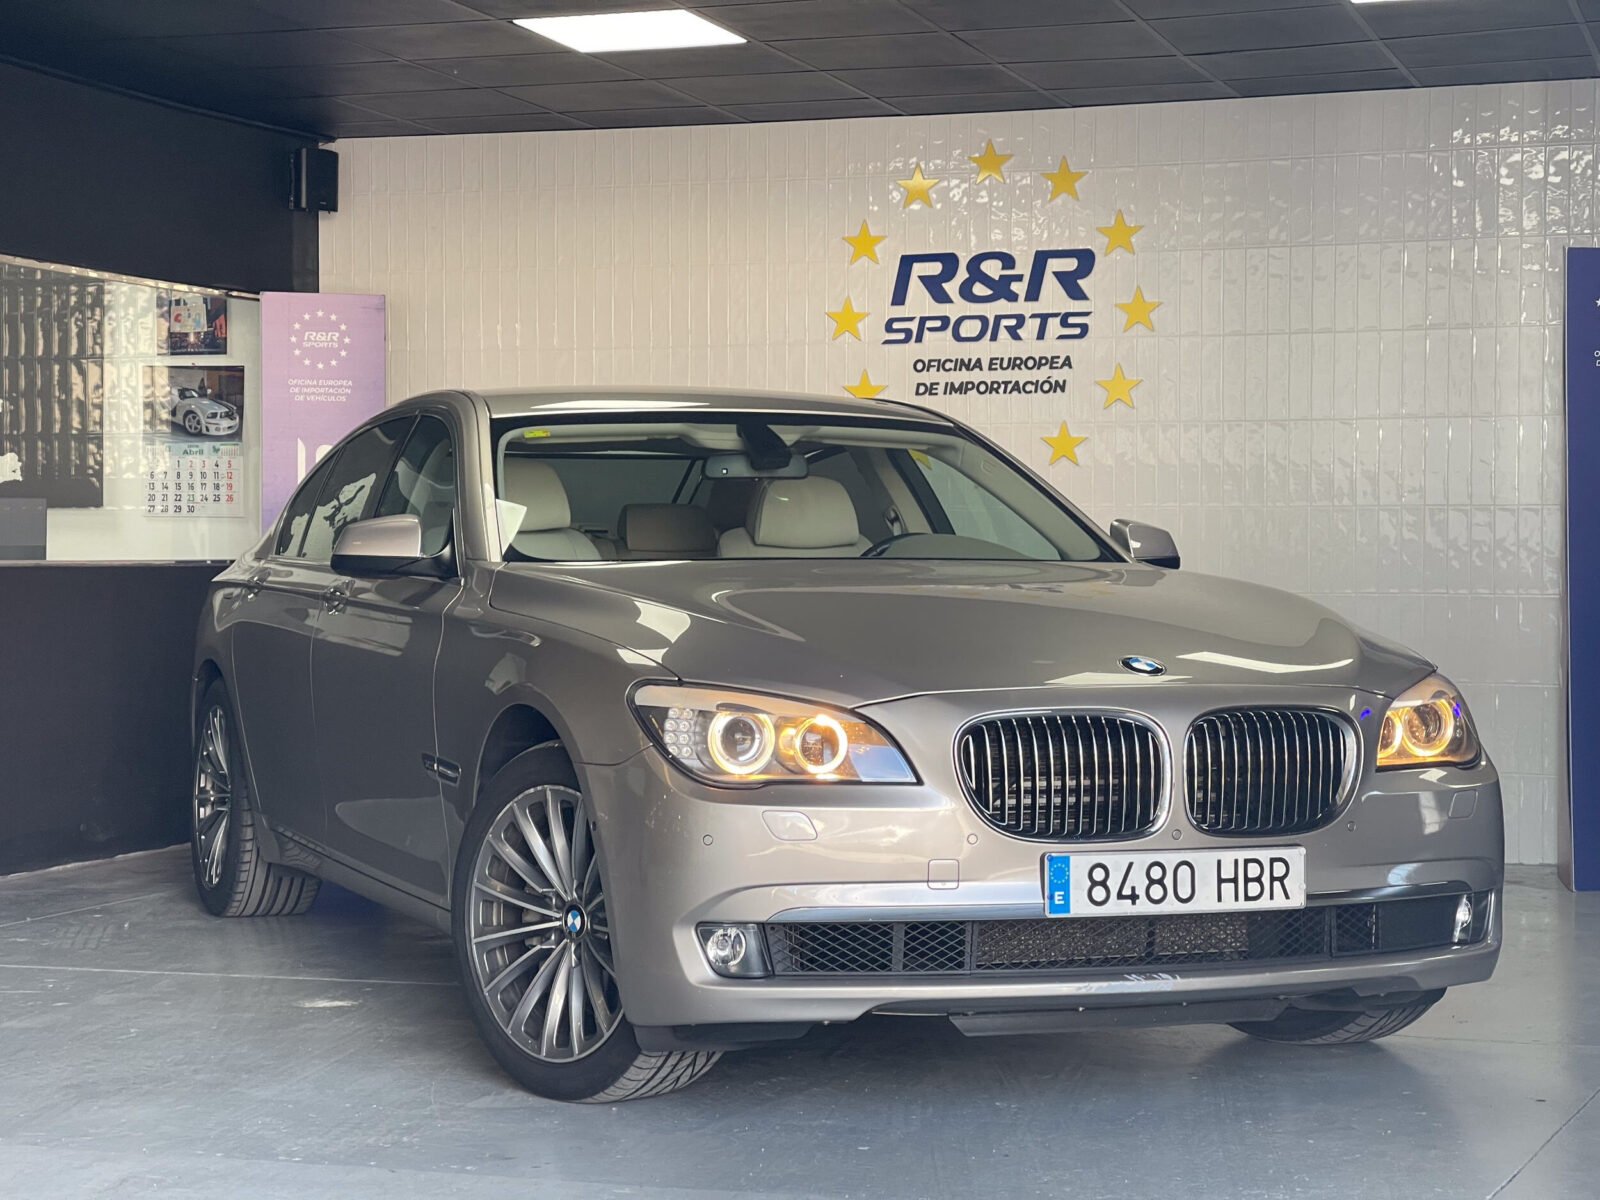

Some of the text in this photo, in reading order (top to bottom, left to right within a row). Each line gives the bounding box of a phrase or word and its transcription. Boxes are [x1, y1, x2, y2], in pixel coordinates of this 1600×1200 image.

[890, 248, 1096, 306] R&R
[881, 311, 1093, 345] SPORTS
[304, 331, 340, 341] R&R
[912, 355, 1072, 373] OFICINA EUROPEA
[318, 379, 352, 387] EUROPEA
[915, 376, 1067, 396] DE IMPORTACIÓN
[301, 386, 351, 394] IMPORTACIÓN
[182, 448, 204, 456] Abril
[177, 460, 232, 468] 1 2 3 4 5
[149, 471, 233, 480] 6 7 8 9 10 11 12
[148, 483, 233, 491] 13 14 15 16 17 18 19
[147, 494, 234, 502] 20 21 22 23 24 25 26
[147, 505, 195, 513] 27 28 29 30
[1087, 857, 1291, 907] 8480 HBR
[1054, 891, 1065, 905] E
